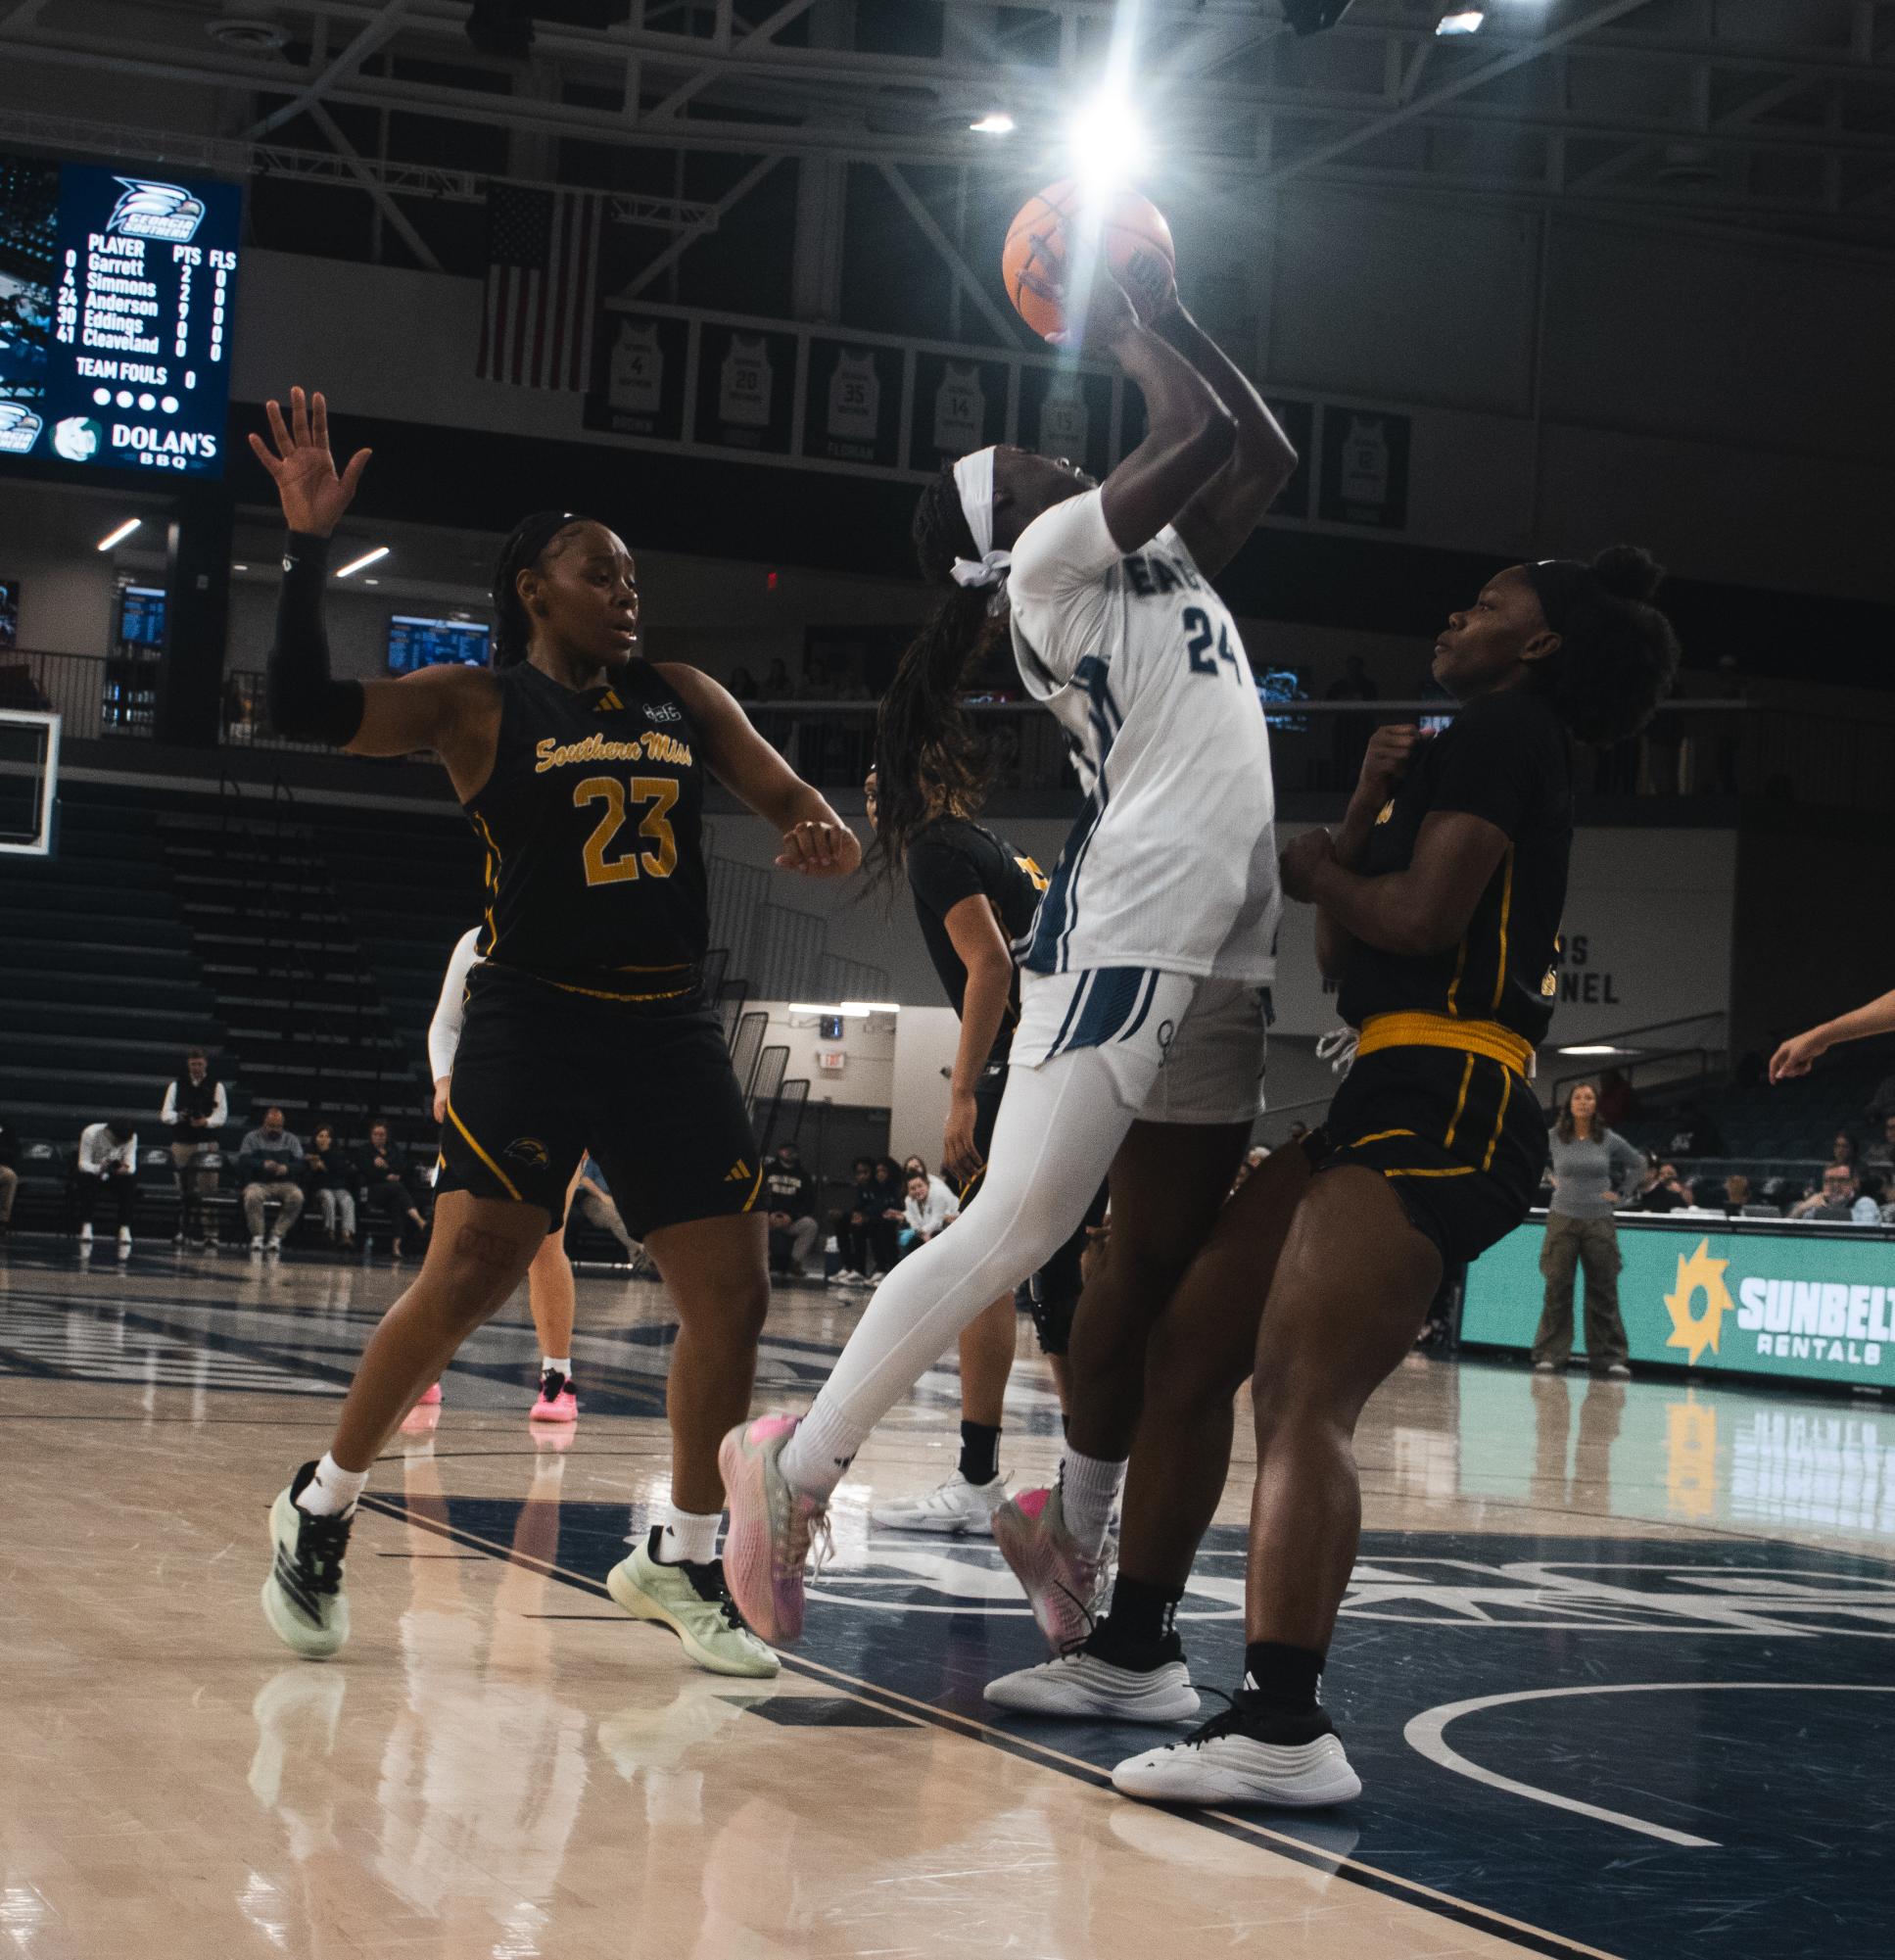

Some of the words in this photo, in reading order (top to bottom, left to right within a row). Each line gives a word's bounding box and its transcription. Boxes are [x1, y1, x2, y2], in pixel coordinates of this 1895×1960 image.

[66, 249, 76, 267] 0
[88, 253, 144, 276] Garrett
[181, 264, 192, 283] 2
[215, 269, 226, 287] 0
[88, 233, 145, 259] PLAYER
[173, 245, 202, 265] PTS
[210, 249, 236, 269] FLS
[64, 267, 74, 286] 4
[86, 271, 156, 297] Simmons
[179, 283, 190, 302] 2
[214, 288, 225, 306] 0
[58, 286, 77, 306] 24
[85, 291, 158, 316] Anderson
[178, 302, 189, 319] 9
[213, 307, 223, 324] 0
[56, 324, 74, 343] 41
[82, 328, 159, 354] Cleaveland
[175, 339, 186, 358] 0
[210, 343, 221, 361] 0
[57, 306, 76, 324] 30
[83, 309, 144, 338] Eddings
[176, 320, 187, 339] 0
[212, 325, 222, 343] 0
[76, 357, 118, 379] TEAM
[119, 362, 167, 385] FOULS
[185, 370, 196, 389] 0
[631, 356, 644, 374] 4
[735, 370, 758, 391] 20
[844, 384, 865, 405] 35
[112, 423, 216, 457] DOLAN'S
[140, 452, 186, 469] BBQ
[1181, 605, 1241, 687] 24
[535, 732, 643, 773] Southern
[640, 731, 692, 767] Miss
[573, 776, 680, 886] 23
[1756, 1333, 1881, 1365] RENTALS
